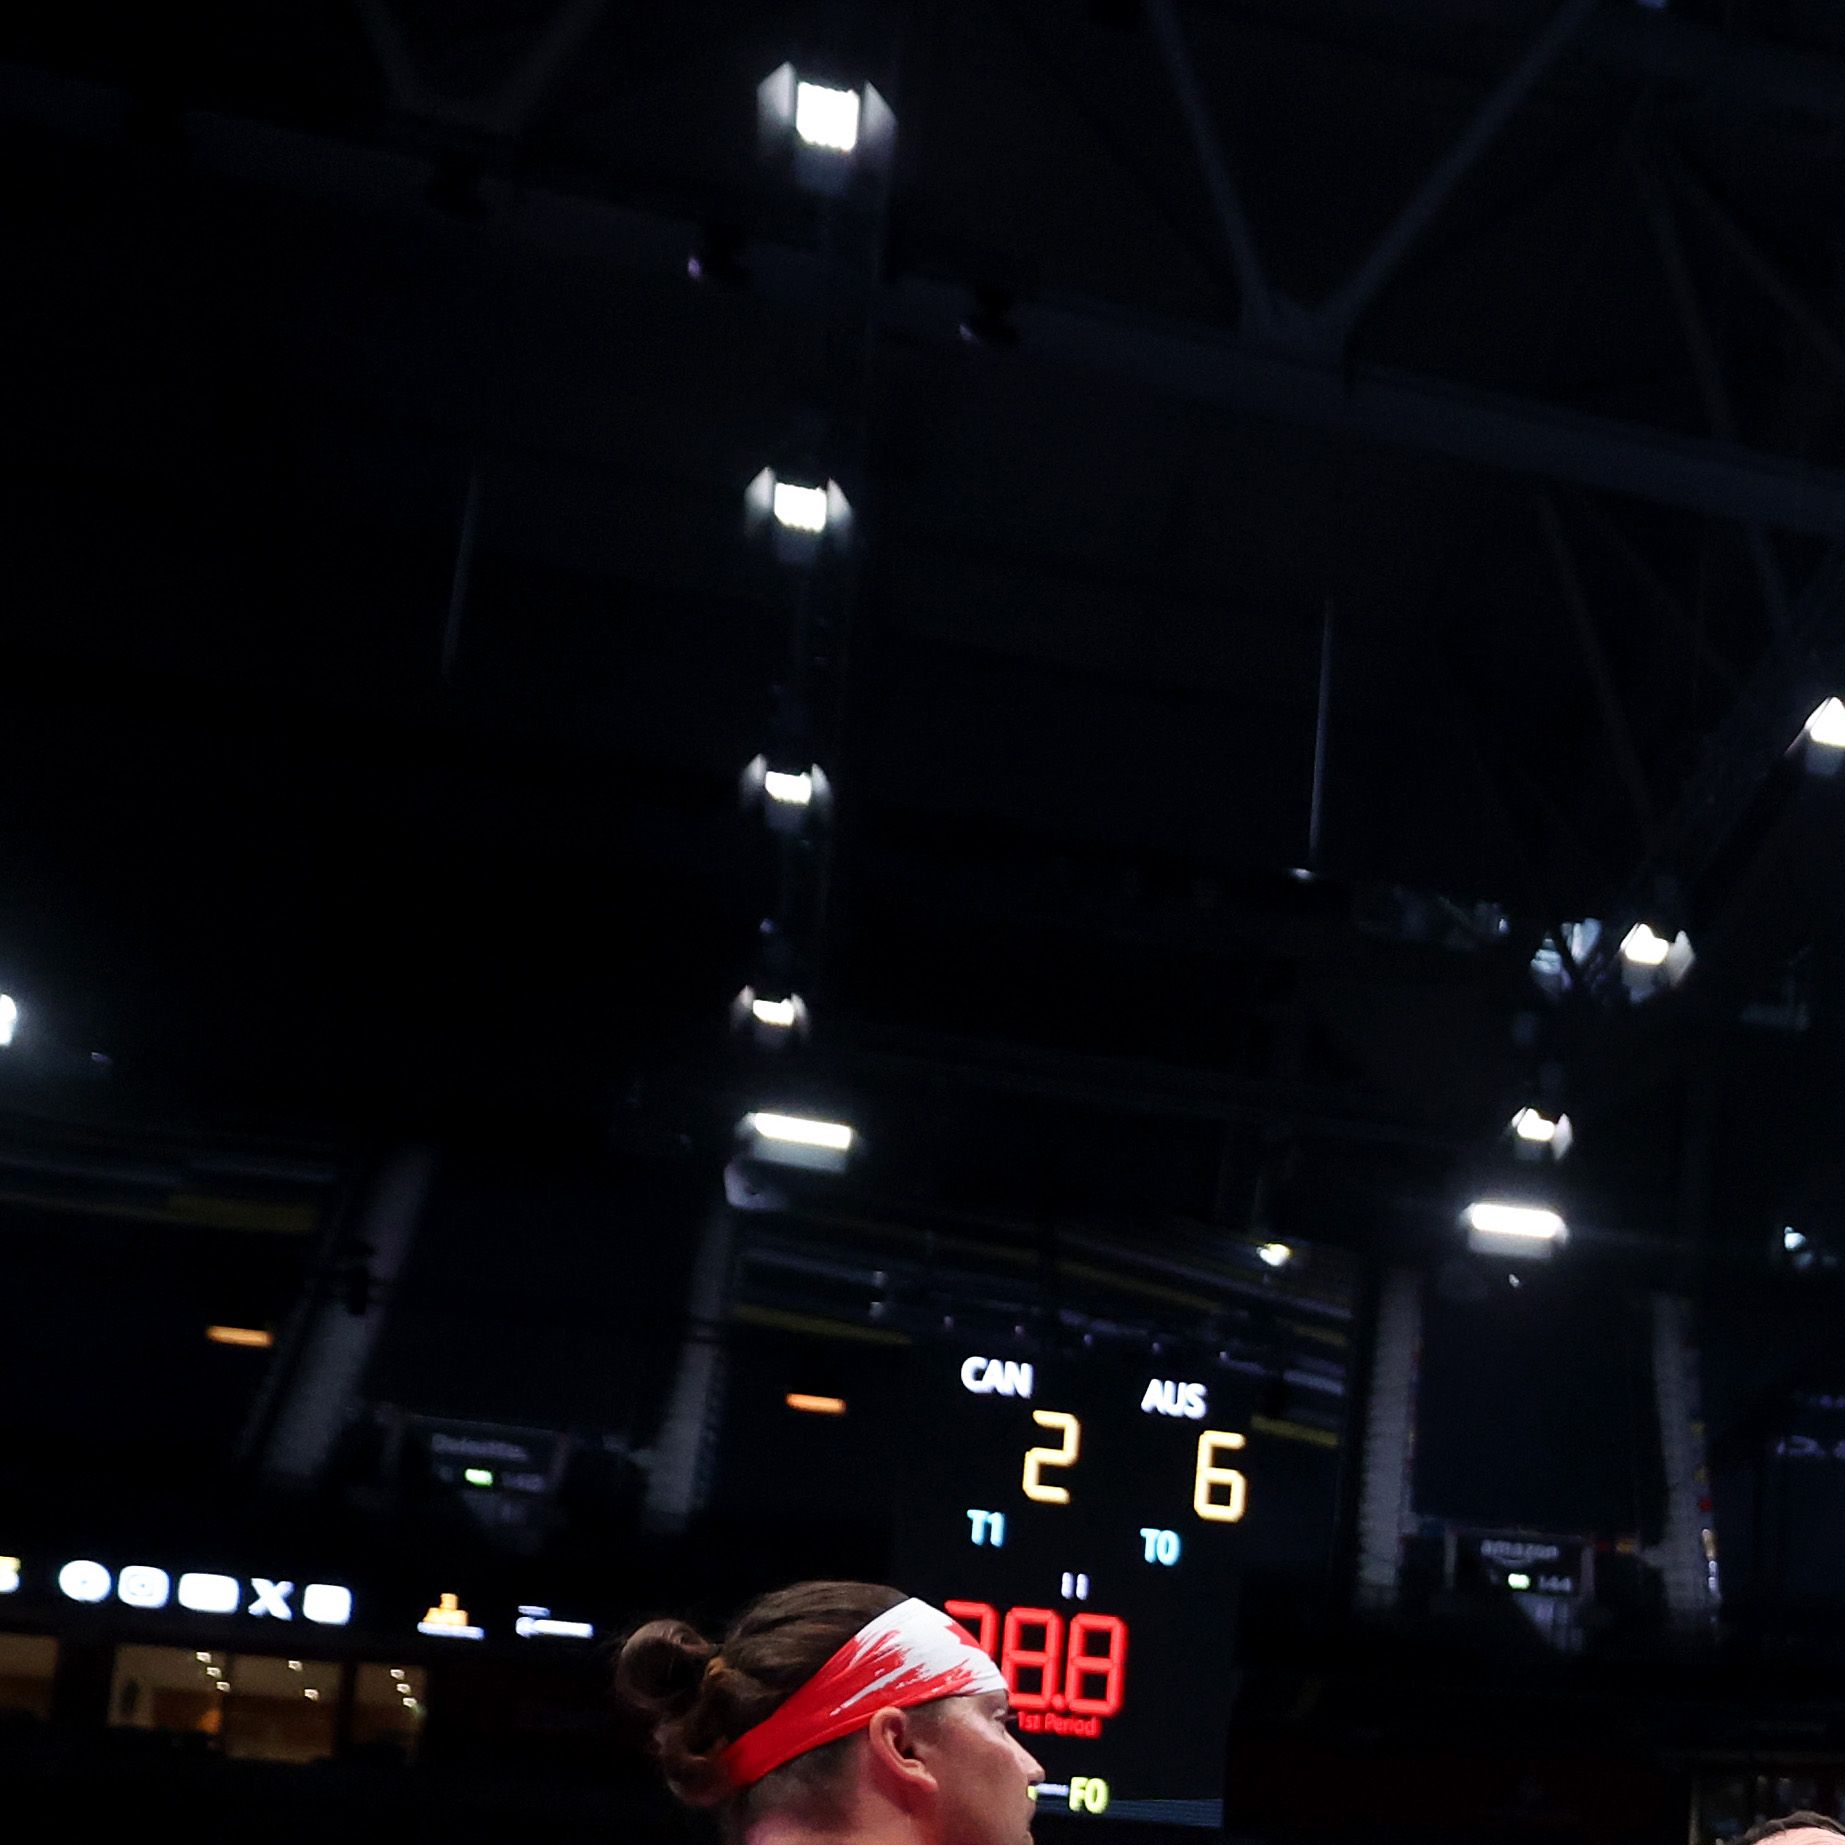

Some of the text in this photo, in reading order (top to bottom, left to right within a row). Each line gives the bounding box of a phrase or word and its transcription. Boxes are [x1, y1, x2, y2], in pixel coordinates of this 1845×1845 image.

[961, 1356, 1034, 1400] CAN
[1141, 1379, 1208, 1421] AUS
[1022, 1410, 1081, 1504] 2
[1193, 1430, 1248, 1523] 6
[967, 1509, 1006, 1548] T1
